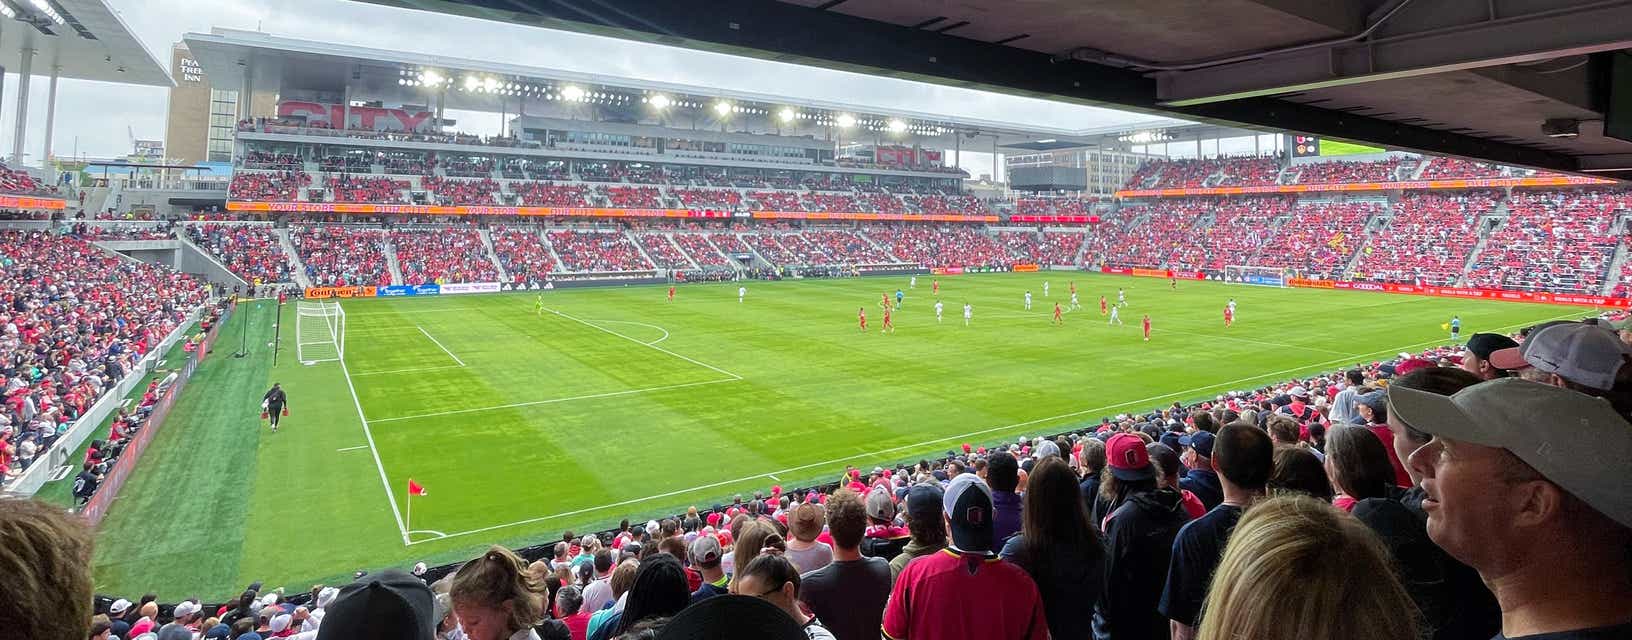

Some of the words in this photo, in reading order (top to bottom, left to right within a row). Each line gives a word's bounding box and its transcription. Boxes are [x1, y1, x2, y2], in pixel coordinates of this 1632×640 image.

[181, 58, 200, 67] PEA
[184, 73, 201, 82] INN
[279, 100, 434, 132] CITY
[269, 203, 299, 212] YOUR
[301, 203, 335, 212] STORE
[374, 206, 400, 214] OUR
[466, 207, 490, 215] YOUR
[494, 207, 519, 216] STORE
